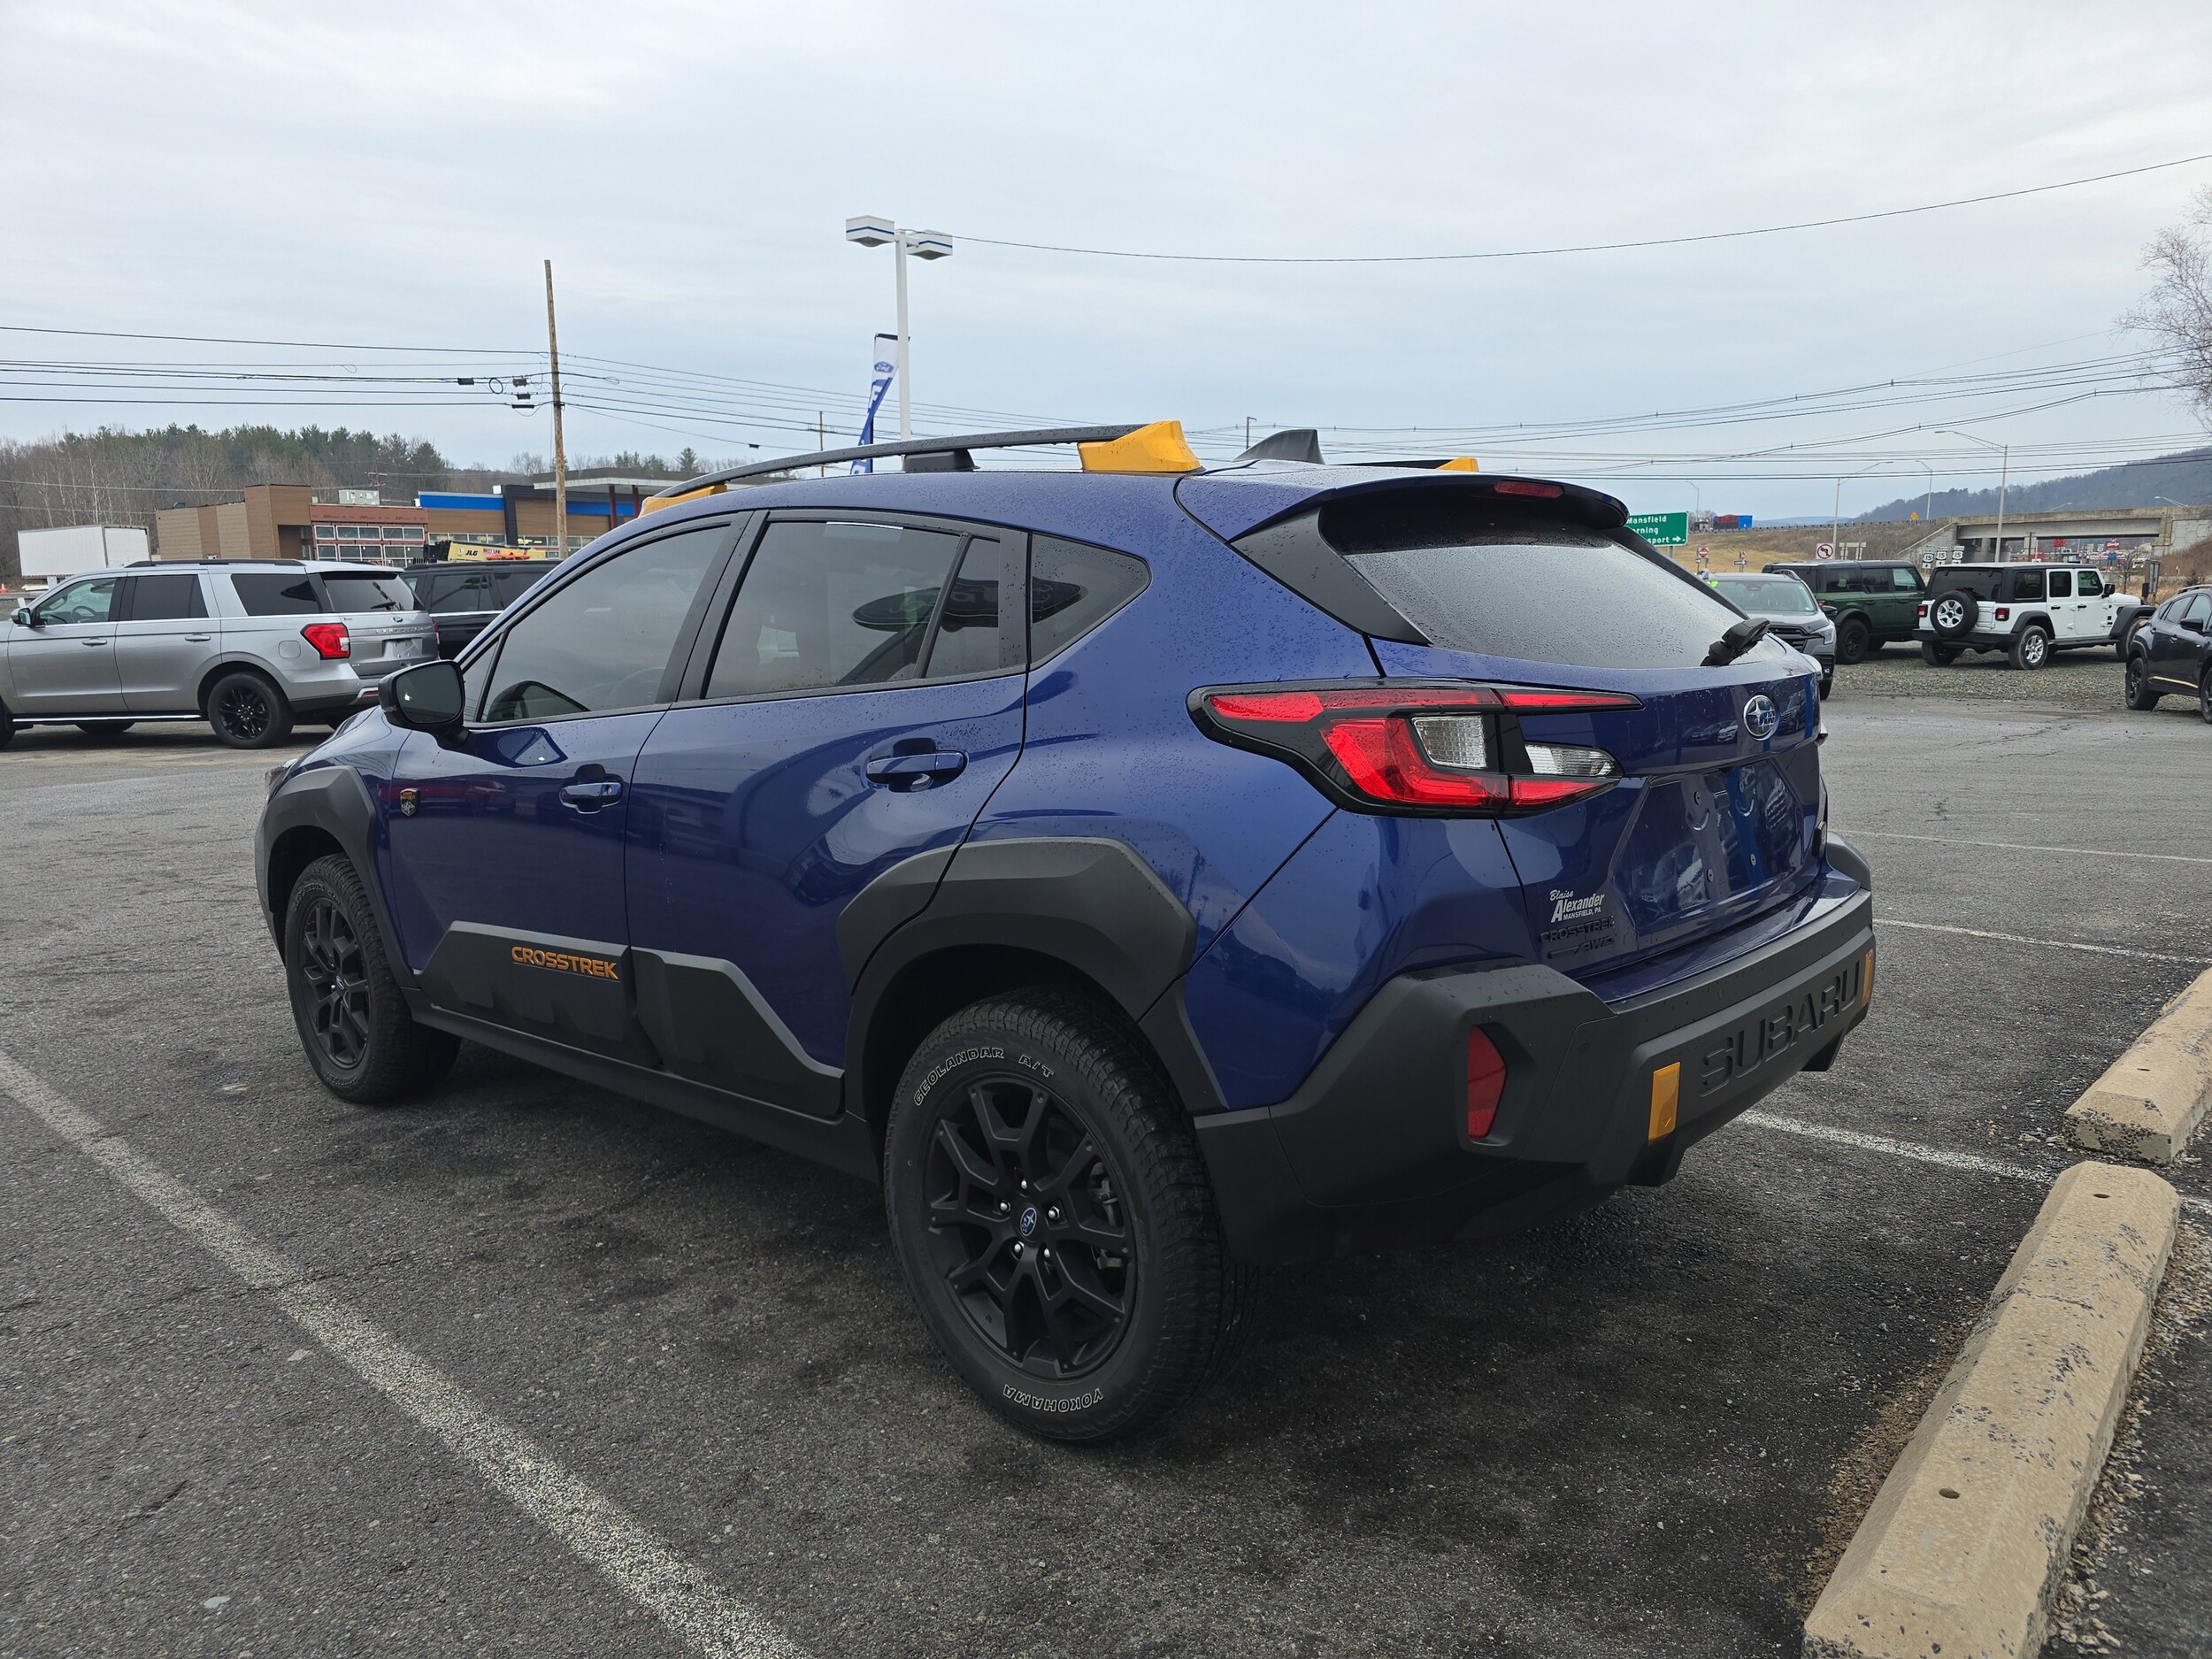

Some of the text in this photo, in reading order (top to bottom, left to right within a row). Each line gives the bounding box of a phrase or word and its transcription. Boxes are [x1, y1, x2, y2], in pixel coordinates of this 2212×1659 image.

[1626, 516, 1667, 525] Mansfield
[1549, 889, 1574, 901] Blaise
[1550, 893, 1605, 923] Alexander
[1540, 915, 1615, 943] CROSSTREK
[1563, 909, 1594, 921] MANSFIELD,
[511, 945, 619, 979] CROSSTREK
[1699, 960, 1860, 1098] SUBARU
[913, 1047, 1055, 1106] GEOLANDAR A/T
[1002, 1384, 1104, 1413] YOKOHAMA
